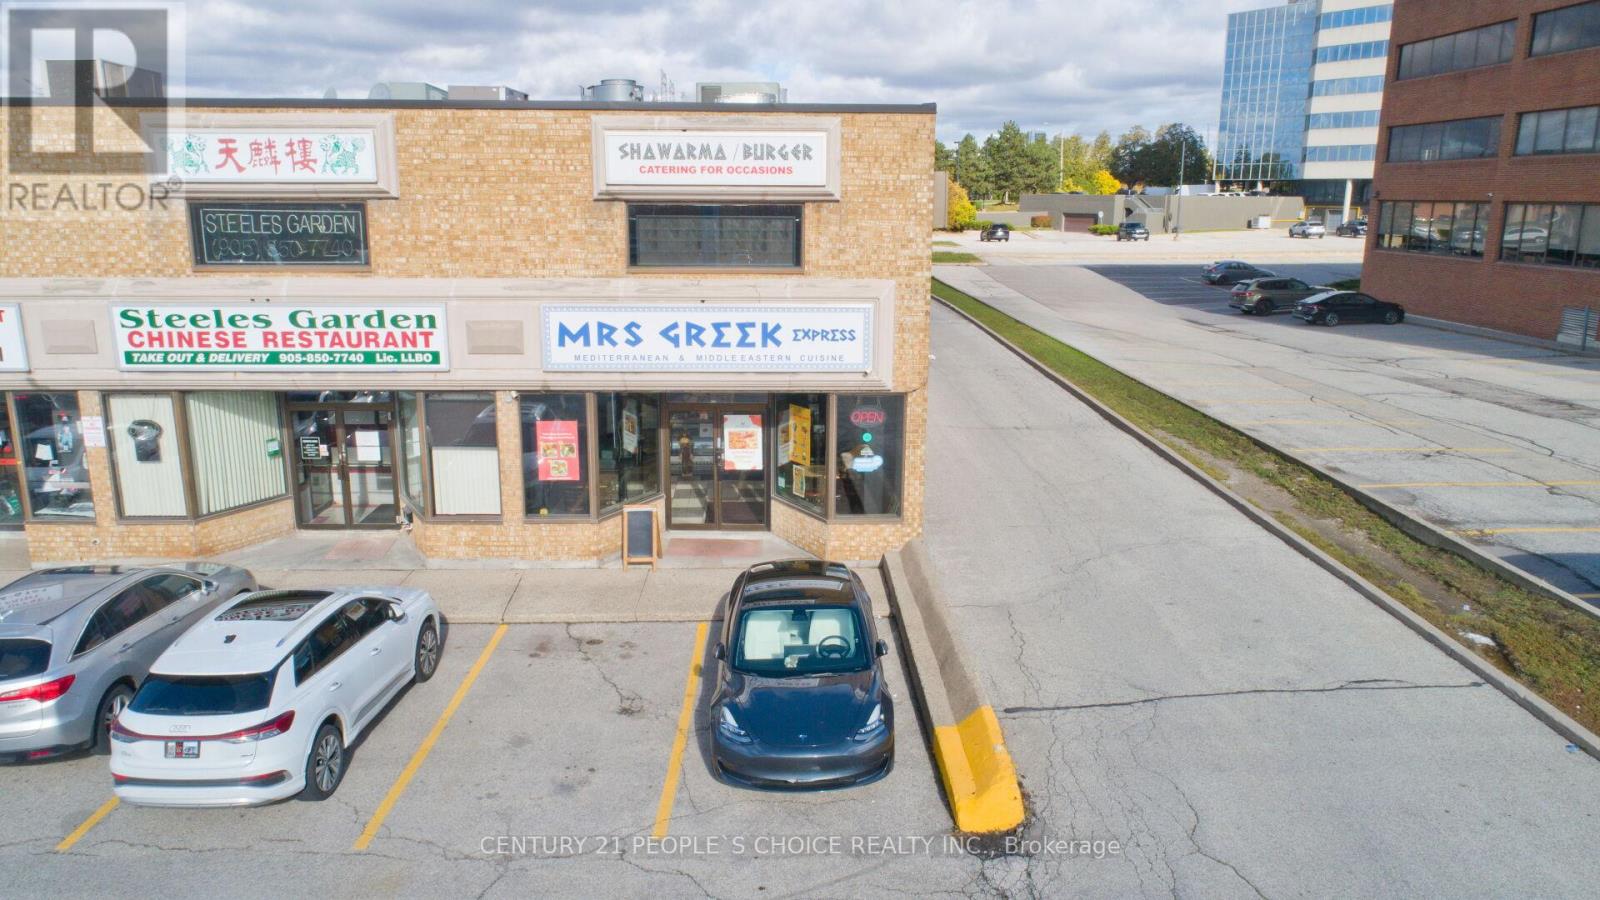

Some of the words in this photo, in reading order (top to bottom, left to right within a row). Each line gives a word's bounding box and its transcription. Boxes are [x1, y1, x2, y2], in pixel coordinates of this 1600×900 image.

[618, 142, 727, 161] SHAWARMA
[742, 142, 813, 161] BURGER
[639, 165, 697, 175] CATERING
[700, 165, 723, 175] FOR
[726, 165, 793, 175] OCCASIONS
[205, 213, 283, 235] STEELES
[286, 214, 355, 234] GARDEN
[119, 308, 273, 329] Steeles
[288, 309, 438, 329] Garden
[127, 330, 248, 349] CHINESE
[262, 330, 434, 349] RESTAURANT
[558, 320, 644, 348] MRS
[132, 353, 165, 363] TAKE
[166, 353, 194, 363] OUT
[195, 353, 206, 363] &
[208, 353, 270, 363] DELIVERY
[279, 353, 364, 363] 905-850-7740
[375, 353, 398, 363] Lic.
[400, 353, 433, 363] LLBO
[574, 354, 669, 362] MEDITERRANEAN
[678, 354, 685, 362] &
[696, 354, 737, 362] MIDDLE
[740, 354, 792, 362] EASTERN
[800, 354, 845, 362] CUISINE
[850, 410, 885, 424] OPEN
